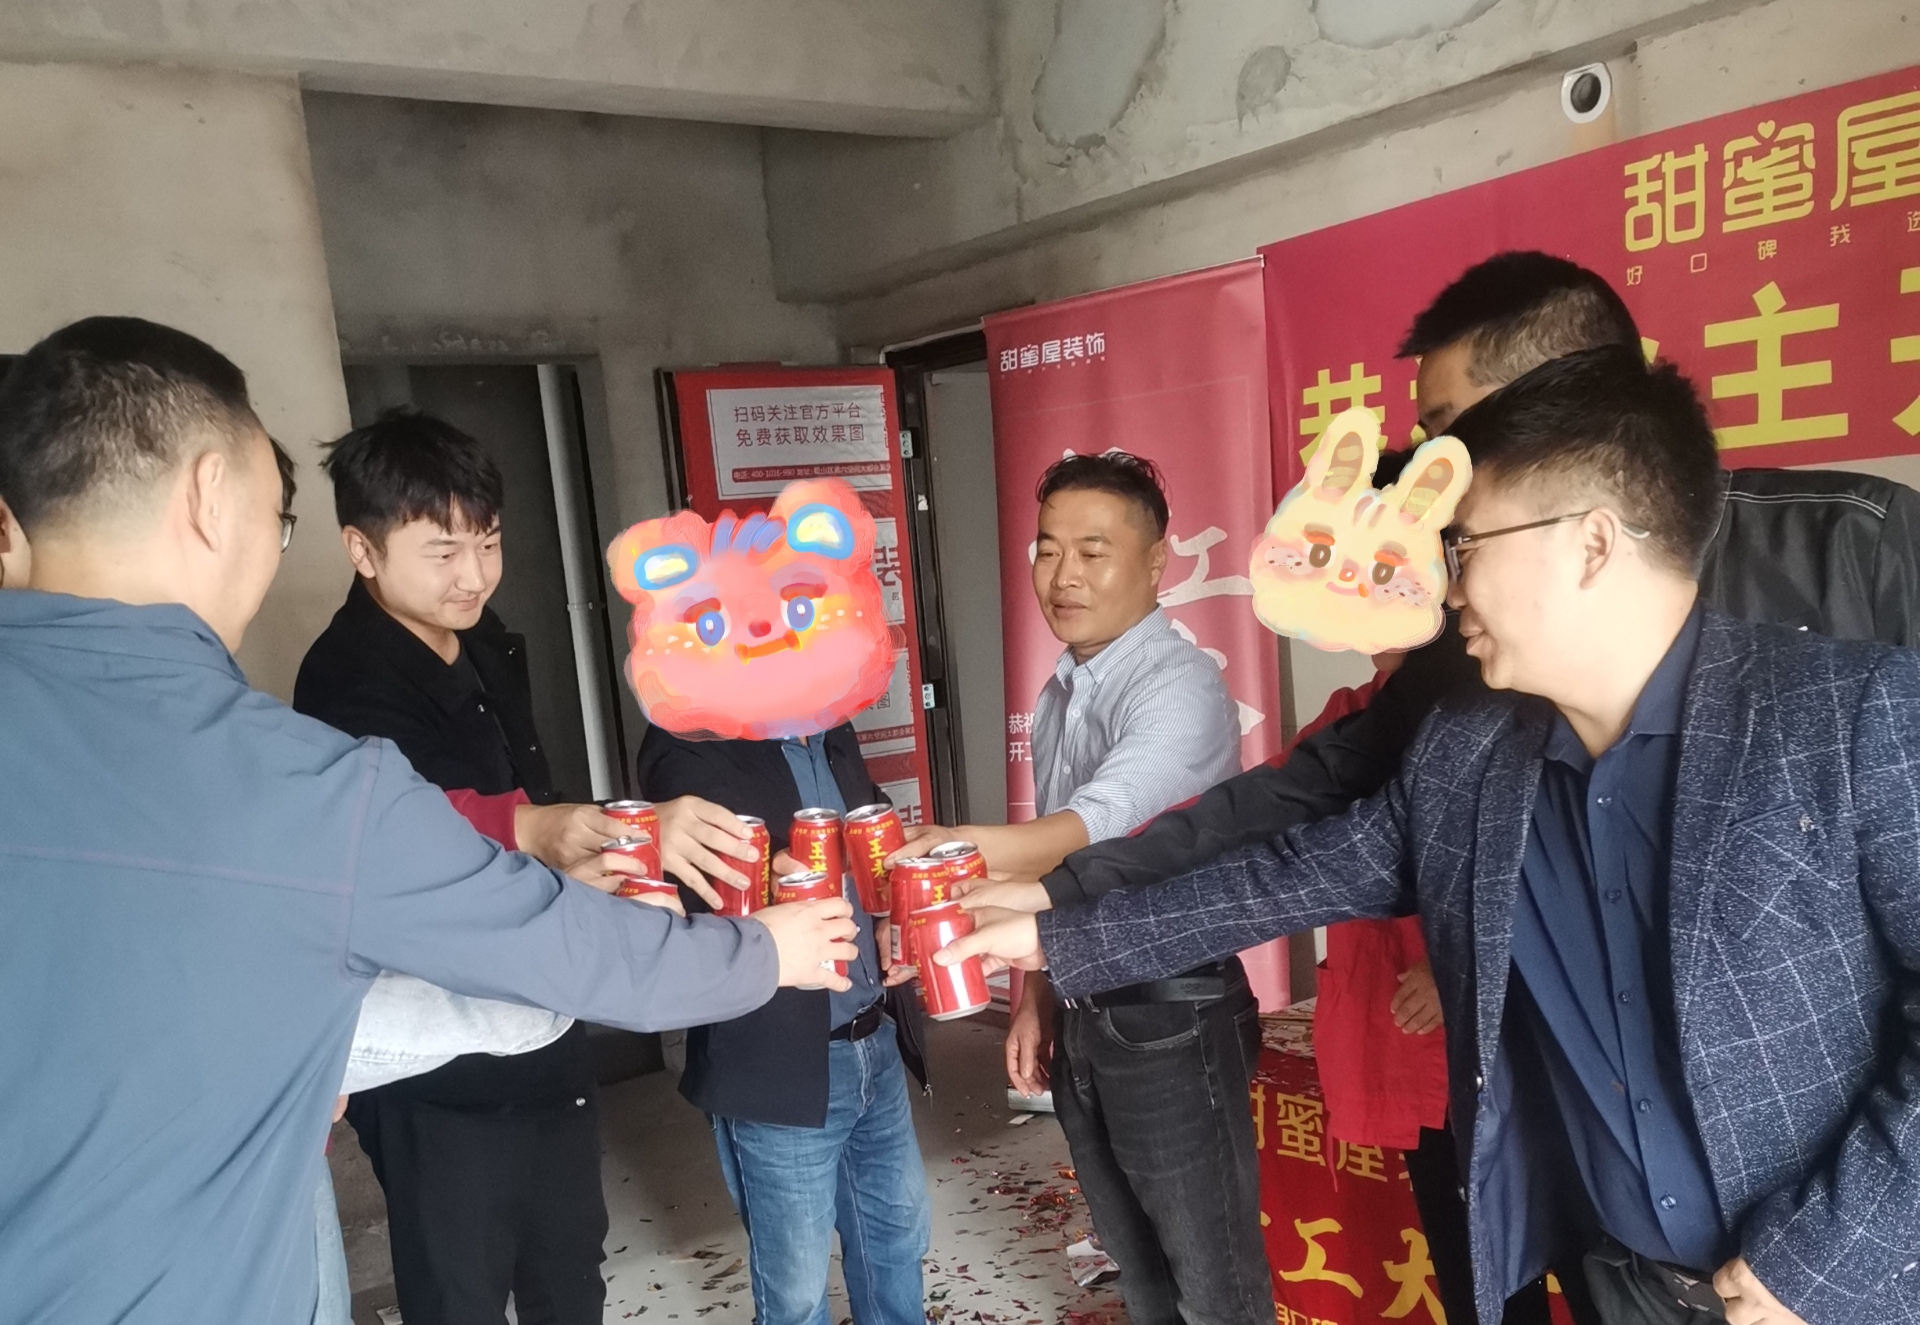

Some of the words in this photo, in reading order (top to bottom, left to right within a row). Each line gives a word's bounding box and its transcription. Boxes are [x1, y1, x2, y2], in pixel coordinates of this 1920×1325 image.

[1624, 90, 1920, 253] 甜蜜屋
[1000, 332, 1106, 372] 甜蜜屋装饰
[733, 401, 862, 423] 扫码关注官方平台
[736, 423, 865, 448] 免费获取效果图
